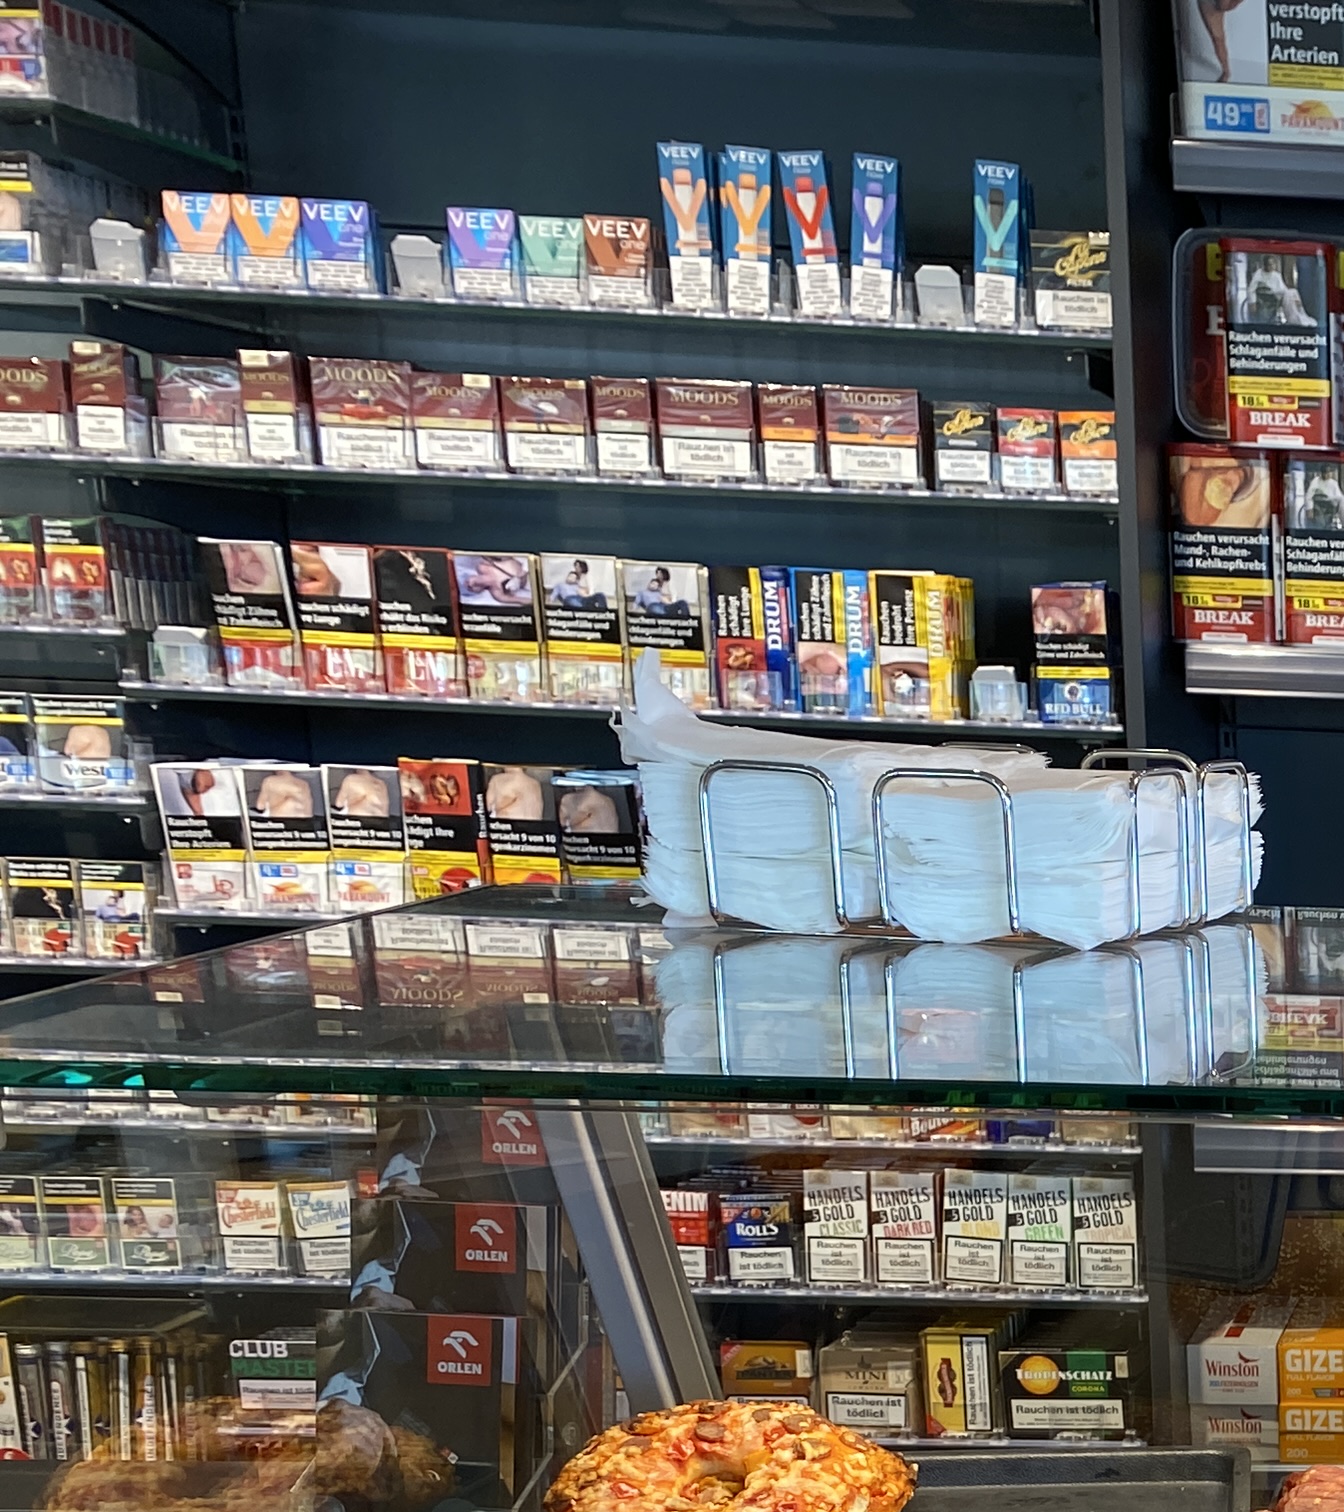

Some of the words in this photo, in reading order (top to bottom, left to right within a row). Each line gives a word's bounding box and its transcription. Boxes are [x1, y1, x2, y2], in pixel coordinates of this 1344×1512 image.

[1270, 22, 1304, 41] Ihre
[1271, 45, 1339, 65] Arterien
[660, 146, 700, 160] VEEV
[781, 154, 819, 168] VEEV
[856, 158, 894, 174] VEEV
[1273, 333, 1327, 346] verursacht
[1298, 347, 1319, 359] und
[1230, 357, 1307, 373] Behinderungen
[671, 390, 739, 405] MOODS
[1249, 411, 1311, 428] BREAK
[763, 580, 783, 651] DRUM
[847, 585, 863, 654] DRUM
[1194, 610, 1254, 625] BREAK
[492, 1142, 537, 1155] ORLEN
[808, 1186, 864, 1207] HANDELS
[875, 1187, 930, 1208] HANDELS
[1011, 1190, 1067, 1211] HANDELS
[823, 1204, 854, 1221] GOLD
[890, 1205, 922, 1223] GOLD
[1026, 1208, 1058, 1226] GOLD
[465, 1249, 508, 1262] ORLEN
[229, 1340, 288, 1358] CLUB
[437, 1362, 483, 1375] ORLEN
[1205, 1358, 1259, 1377] Winston
[1065, 1405, 1079, 1416] ist
[1081, 1405, 1119, 1416] tödlich
